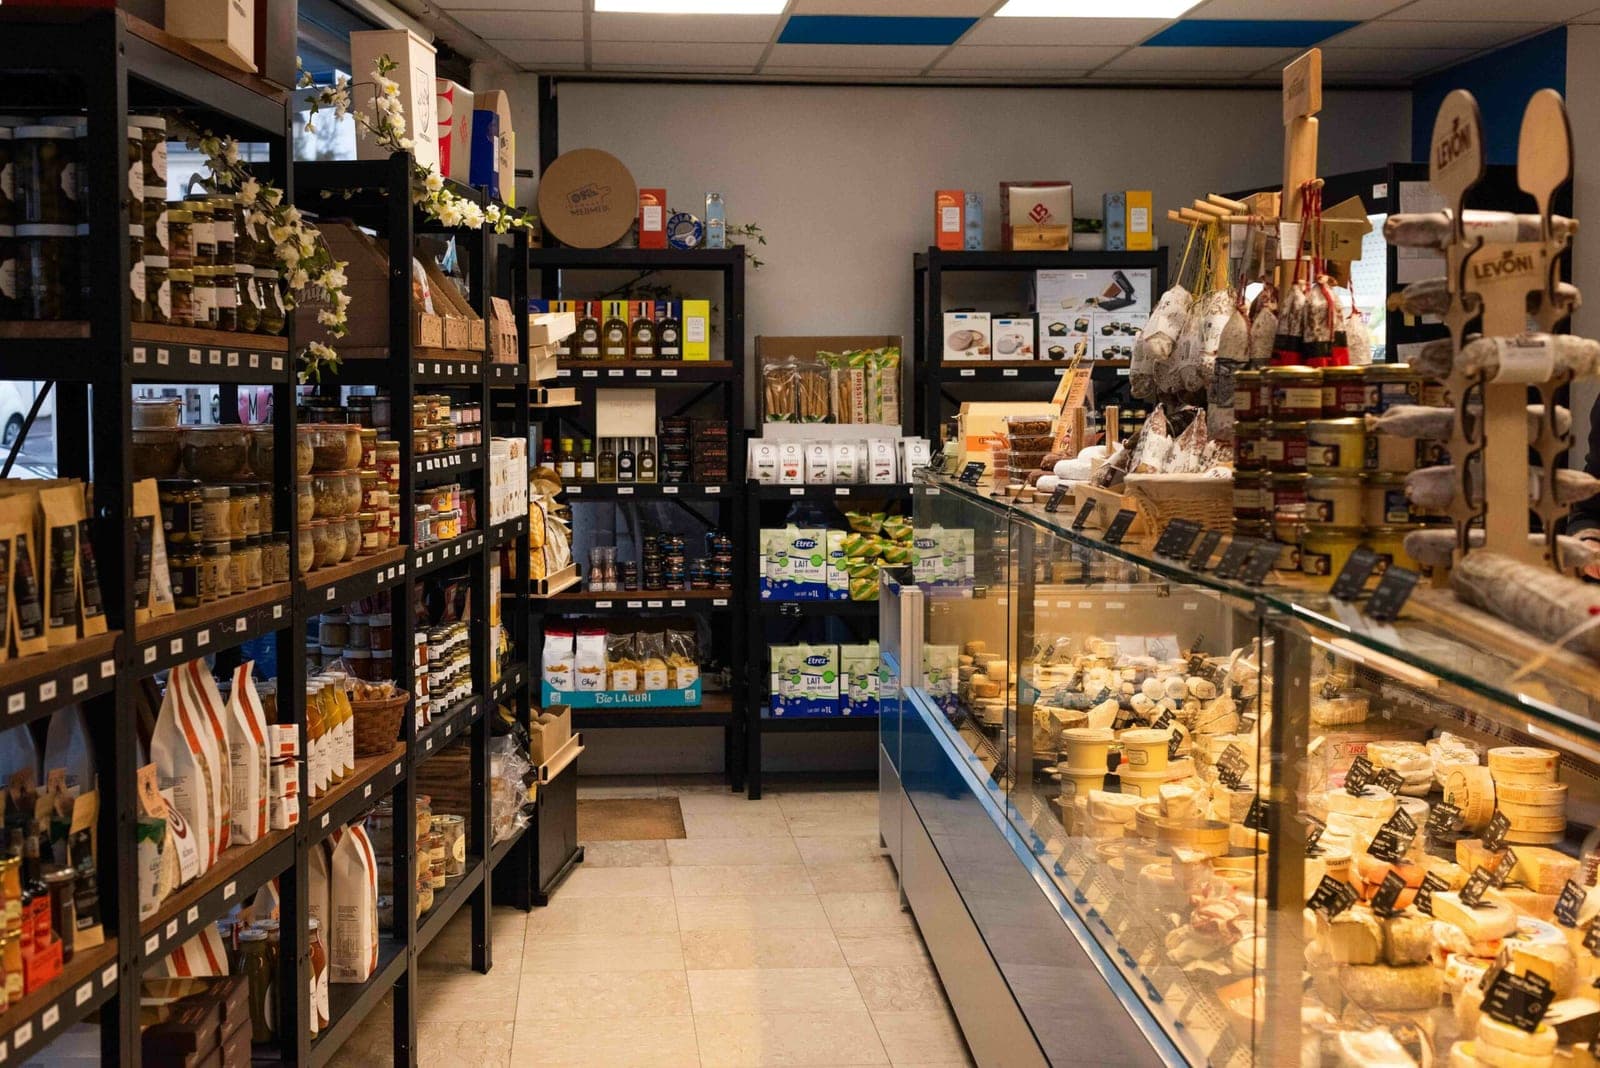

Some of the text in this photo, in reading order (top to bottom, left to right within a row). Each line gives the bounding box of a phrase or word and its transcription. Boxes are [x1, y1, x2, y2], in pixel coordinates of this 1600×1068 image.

[1473, 255, 1534, 279] LEVONI
[795, 540, 814, 548] Etrez
[794, 560, 808, 568] LAIT
[807, 657, 826, 665] Etrez
[595, 692, 613, 704] Bio
